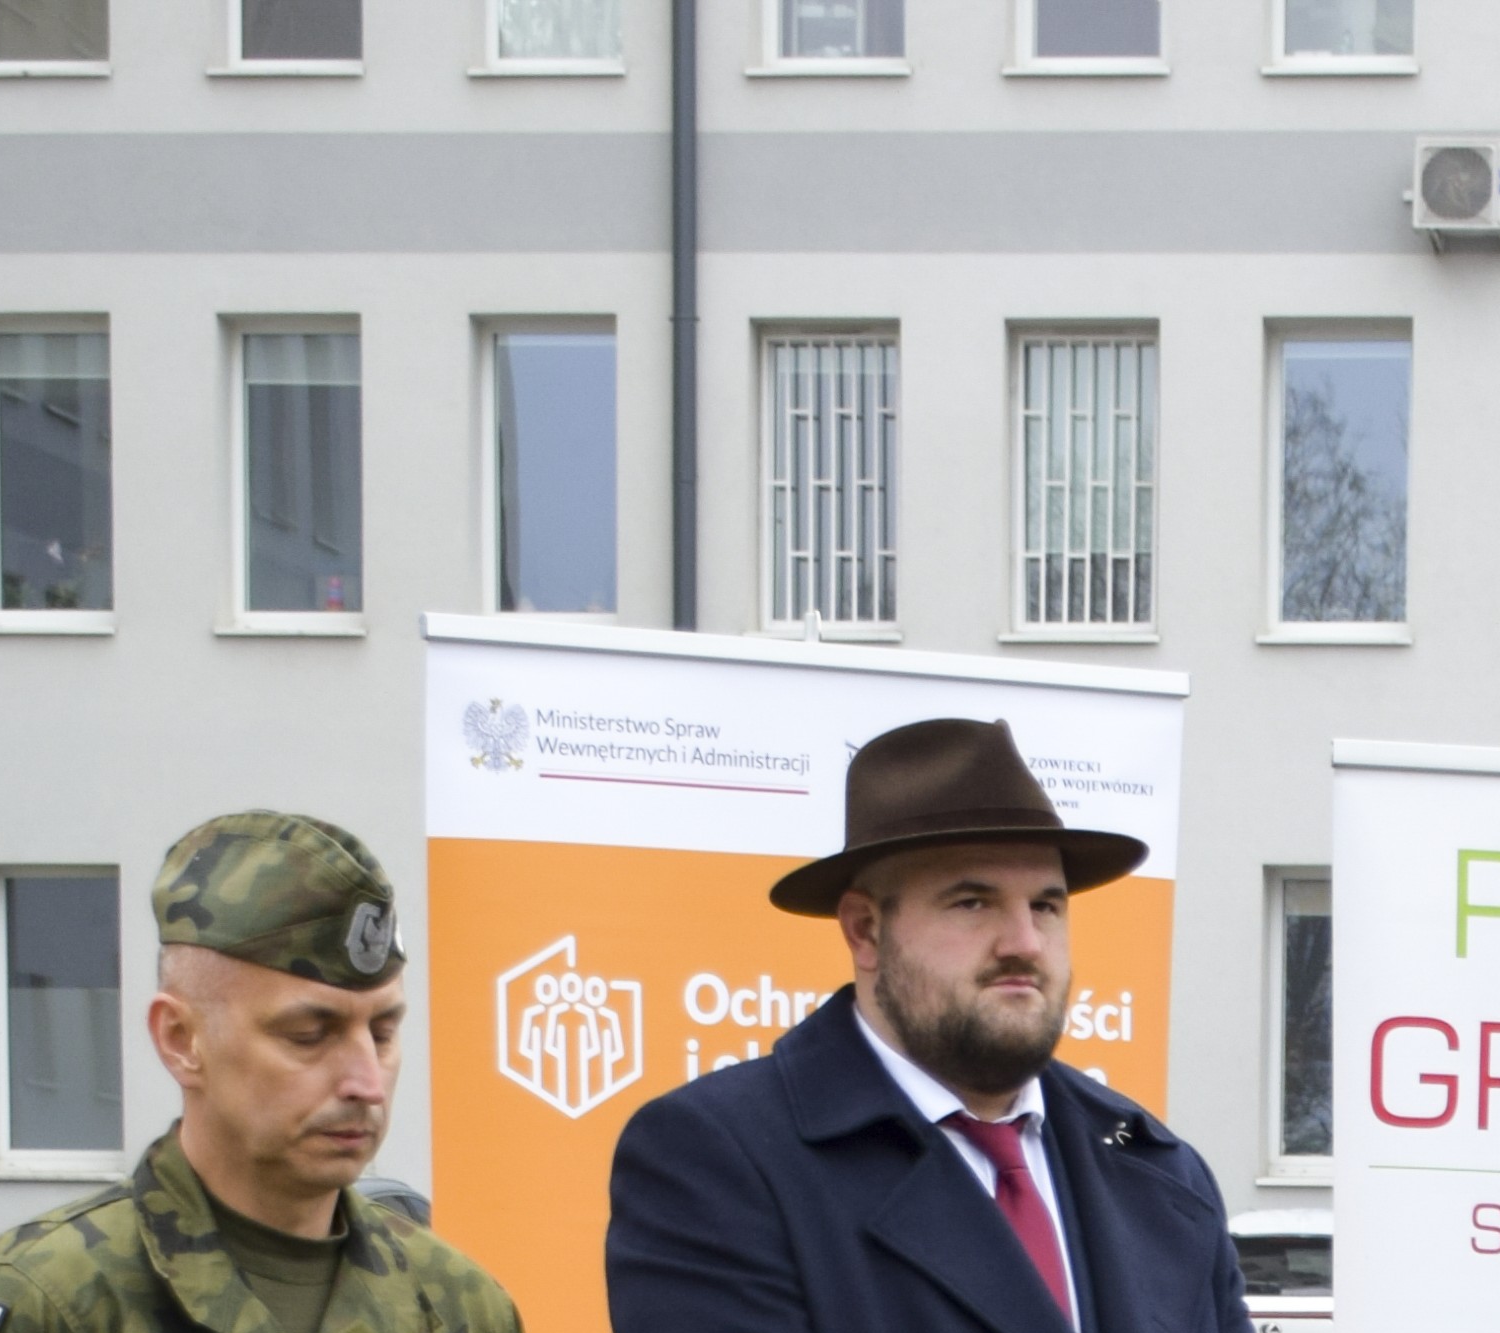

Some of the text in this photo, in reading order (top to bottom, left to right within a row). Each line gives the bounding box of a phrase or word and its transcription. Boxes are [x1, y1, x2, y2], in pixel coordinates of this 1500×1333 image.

[536, 709, 720, 740] Ministerstwo Spraw
[536, 736, 810, 777] Wewnętrznych i Administracji
[1029, 757, 1102, 774] ZOWIECKI
[1062, 777, 1154, 797] WOJEWÓDZKI
[684, 973, 834, 1027] Ochr
